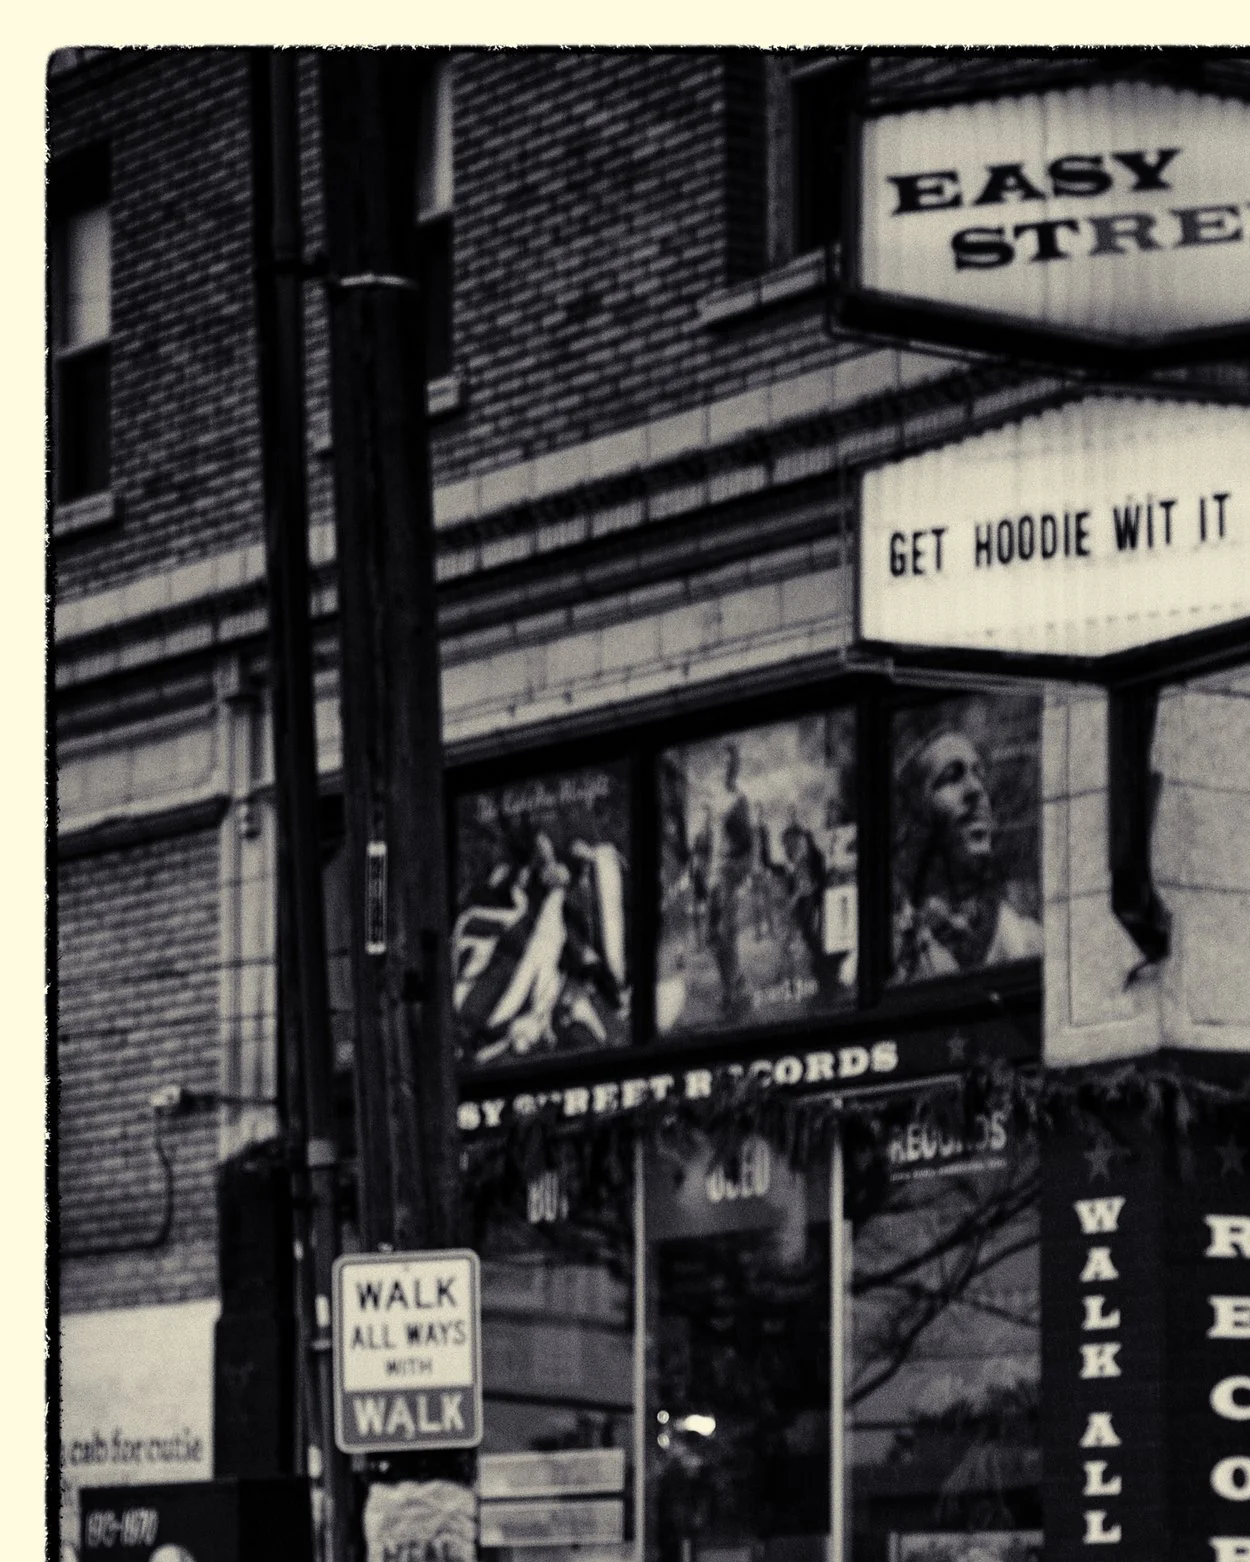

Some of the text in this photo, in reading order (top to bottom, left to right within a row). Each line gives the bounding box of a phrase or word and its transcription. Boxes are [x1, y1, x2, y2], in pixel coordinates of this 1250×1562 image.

[888, 148, 1181, 215] EASY
[889, 493, 1232, 576] GET HOODIE WIT IT
[356, 1276, 458, 1312] WALK
[1073, 1196, 1126, 1379] WALK
[351, 1319, 467, 1351] ALL WAYS
[385, 1357, 433, 1378] WITH
[352, 1391, 465, 1437] WALK
[1078, 1411, 1124, 1545] ALL
